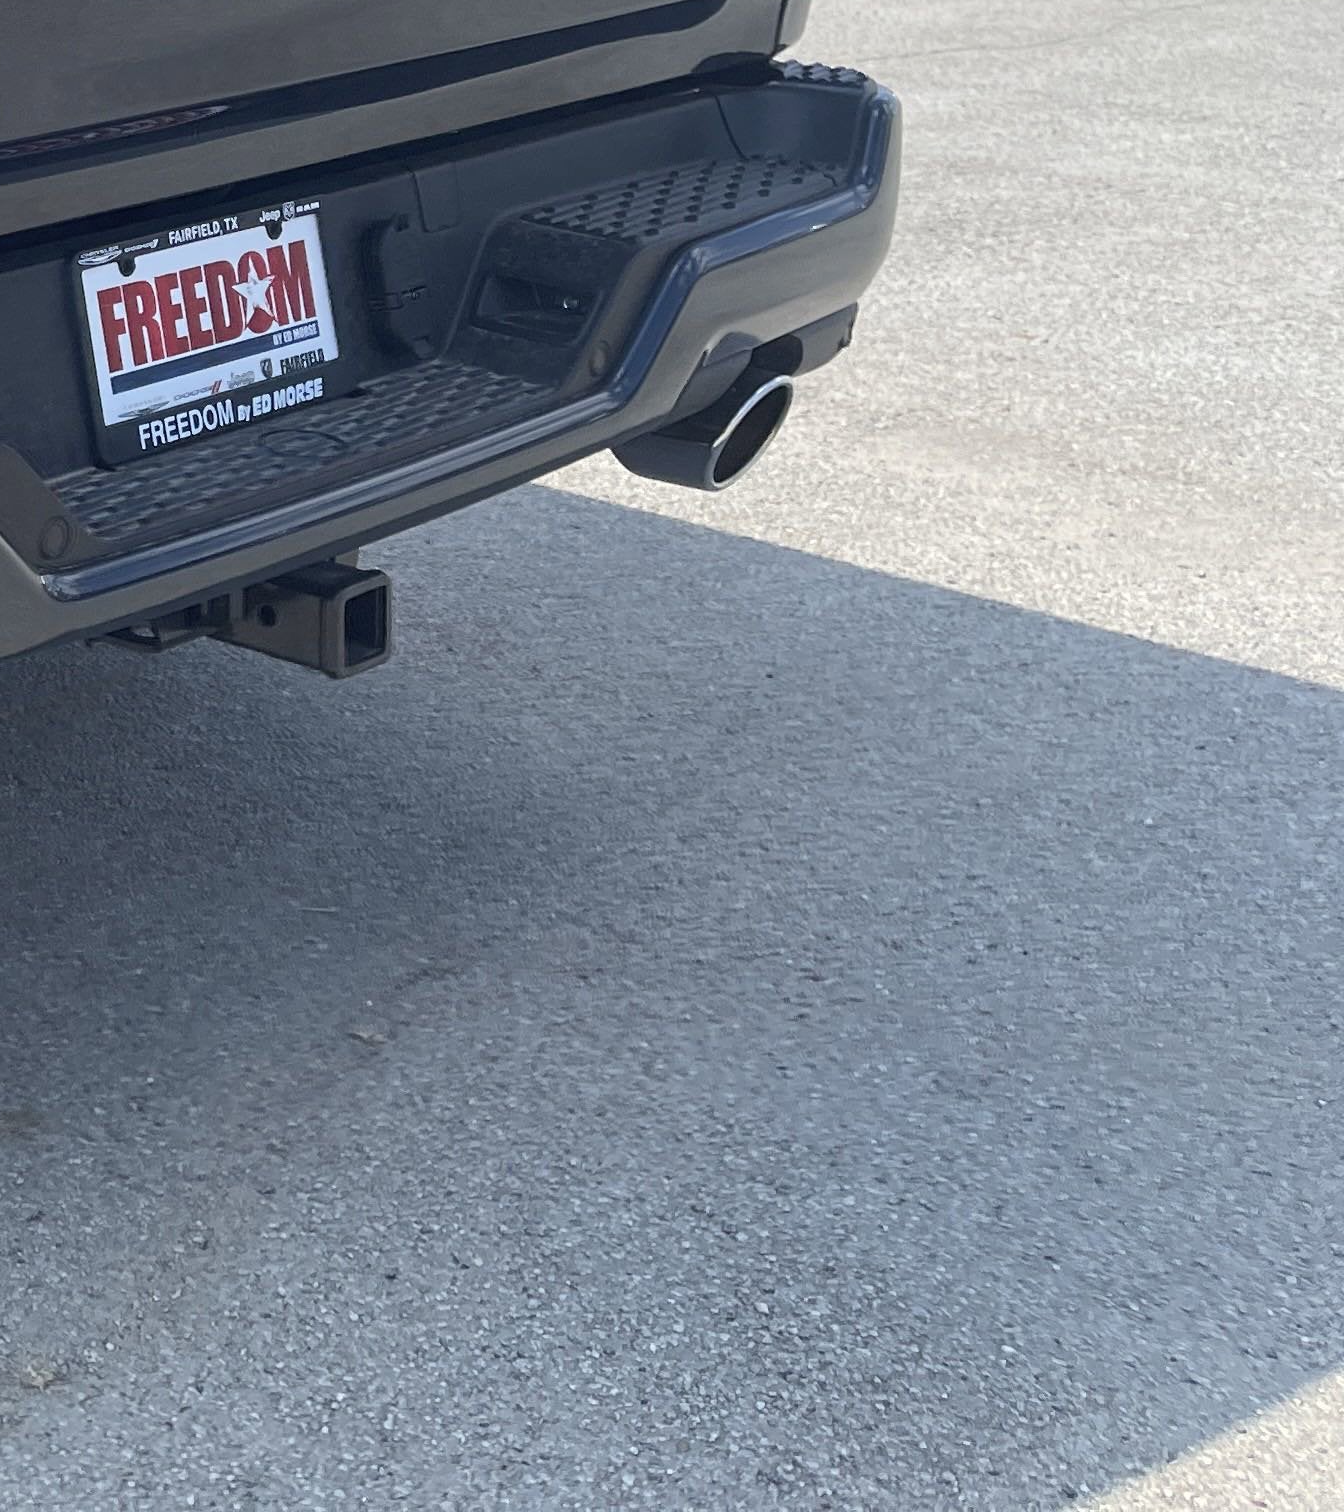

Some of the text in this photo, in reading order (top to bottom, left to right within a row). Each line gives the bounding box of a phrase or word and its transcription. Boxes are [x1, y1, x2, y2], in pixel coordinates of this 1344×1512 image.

[168, 221, 223, 245] FAIRFIELD,
[224, 216, 239, 231] TX
[259, 210, 281, 223] Jeep
[96, 239, 317, 373] FREEDOM
[138, 398, 235, 450] FREEDOM
[252, 394, 272, 417] ED
[273, 377, 324, 410] MORSE
